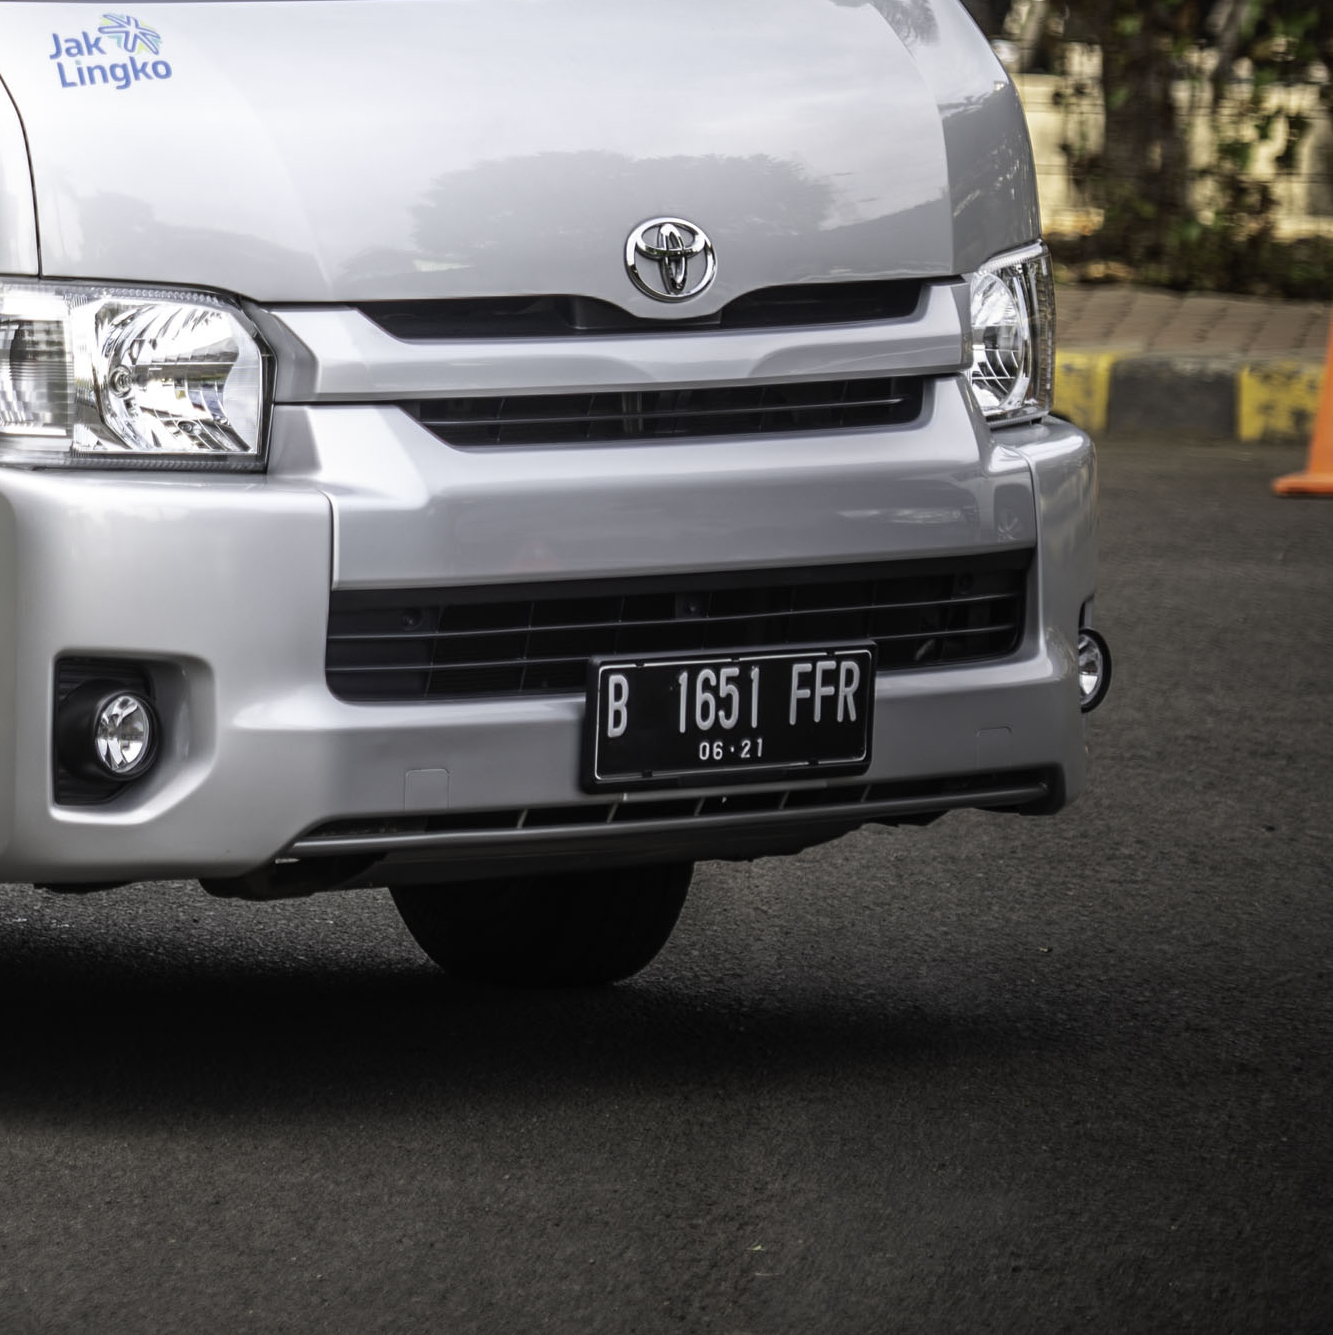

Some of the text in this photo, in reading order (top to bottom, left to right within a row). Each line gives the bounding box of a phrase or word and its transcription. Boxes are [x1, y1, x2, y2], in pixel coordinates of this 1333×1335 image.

[49, 31, 108, 59] Jak
[56, 56, 173, 90] Lingko
[607, 660, 861, 737] B 1651 FFR
